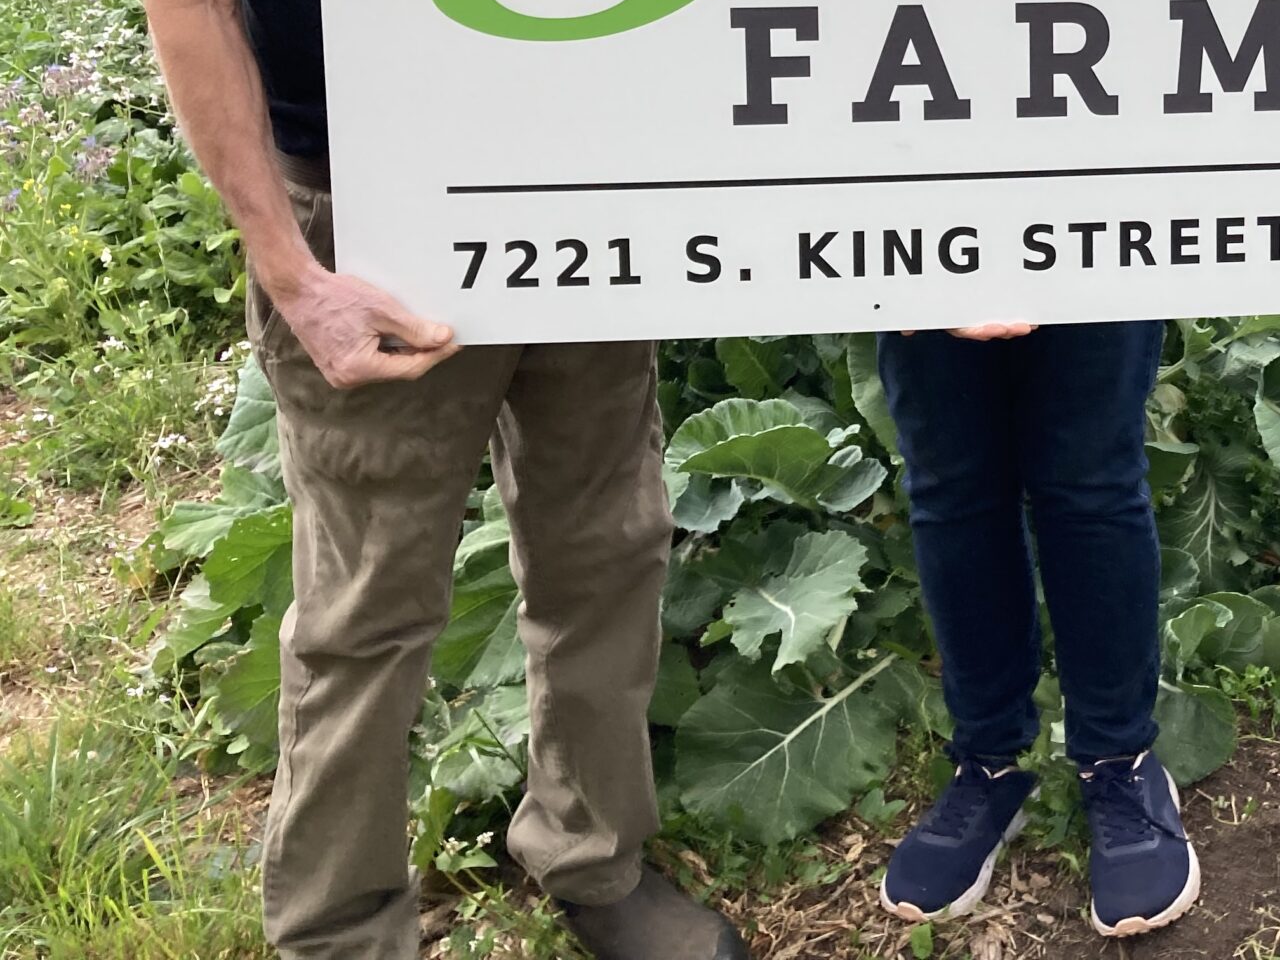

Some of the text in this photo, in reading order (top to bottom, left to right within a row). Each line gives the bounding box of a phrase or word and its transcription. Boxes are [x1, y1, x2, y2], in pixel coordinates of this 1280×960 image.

[453, 238, 642, 289] 7221
[685, 235, 752, 284] S.
[798, 226, 980, 280] KING
